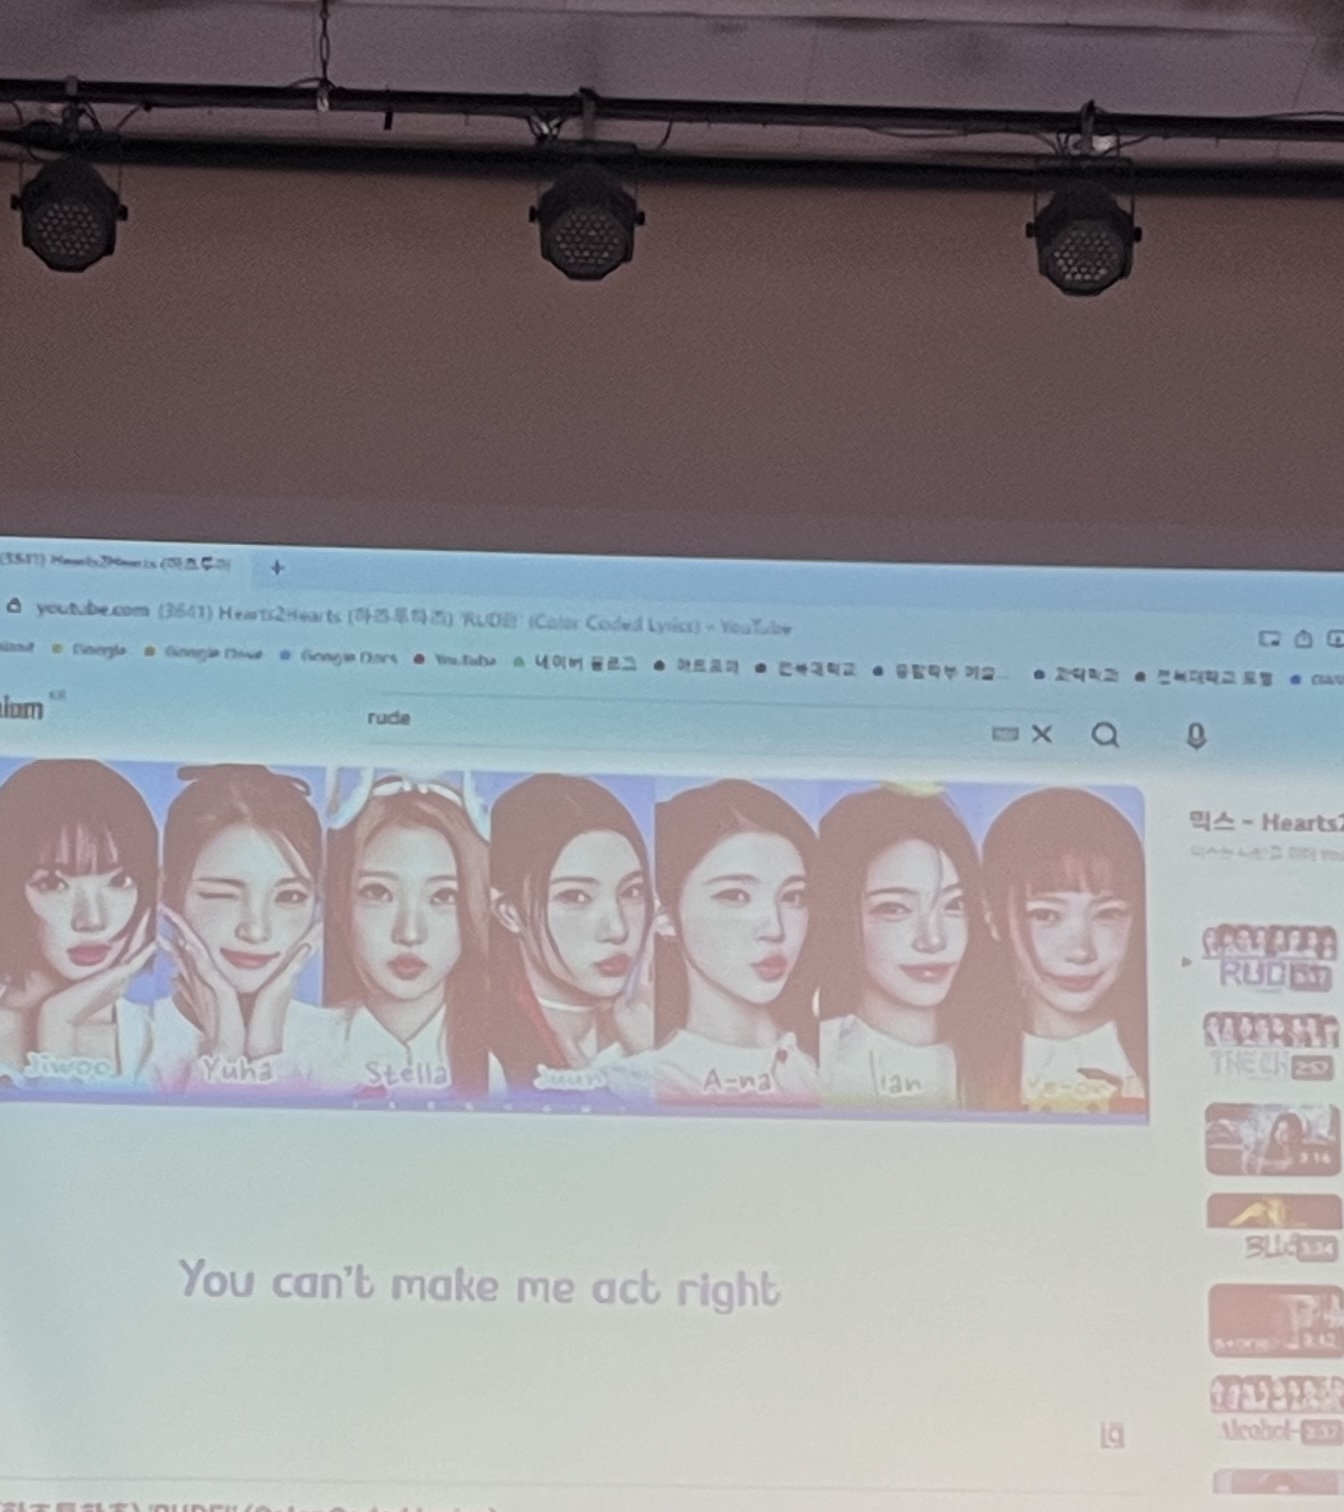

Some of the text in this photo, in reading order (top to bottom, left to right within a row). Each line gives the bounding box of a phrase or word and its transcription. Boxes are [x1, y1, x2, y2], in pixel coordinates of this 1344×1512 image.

[36, 601, 150, 618] youtube.com
[367, 710, 411, 726] rude
[1189, 810, 1236, 832] 믹스
[201, 1057, 275, 1083] Yuha
[364, 1060, 448, 1087] Stella
[703, 1068, 774, 1094] A-na
[178, 1257, 782, 1316] You can't make me act right
